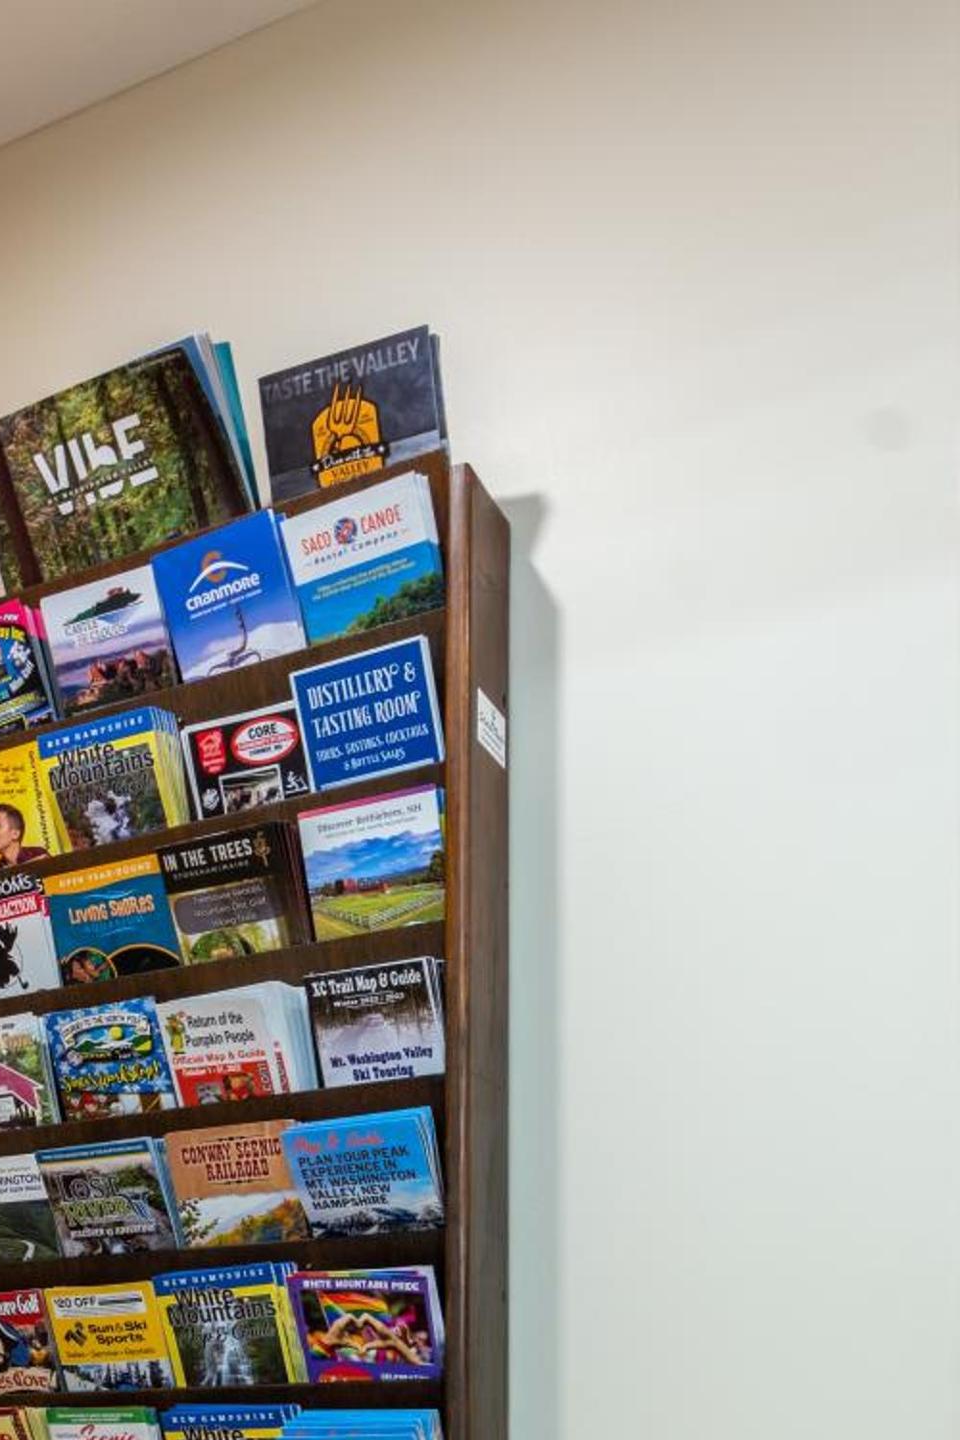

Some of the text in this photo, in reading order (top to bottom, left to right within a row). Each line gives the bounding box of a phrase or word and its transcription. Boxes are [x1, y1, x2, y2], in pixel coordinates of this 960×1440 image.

[263, 338, 420, 400] TASTE THE VALLEY
[301, 505, 401, 556] SACO CANOE
[307, 661, 416, 710] DISTILLERY &
[312, 691, 421, 739] TASTING ROOM
[46, 715, 144, 749] NEW HAMPSHIRE
[248, 723, 278, 740] CORE
[56, 742, 115, 770] White
[49, 751, 155, 791] Mountains
[406, 802, 422, 814] NH
[163, 838, 253, 871] IN THE TREES
[329, 978, 353, 995] Trail
[355, 976, 377, 993] Map
[389, 969, 421, 986] Guide
[218, 1012, 227, 1025] of
[228, 1012, 243, 1024] the
[224, 1029, 256, 1045] People
[347, 1051, 402, 1067] Washington
[402, 1046, 433, 1061] Valley
[352, 1064, 414, 1081] Ski Touring
[181, 1138, 281, 1164] CONWAY SCENIC
[298, 1146, 410, 1167] PLAN YOUR PEAK
[206, 1159, 270, 1182] RAILROAD
[301, 1160, 397, 1179] EXPERIENCE IN
[329, 1171, 416, 1186] WASHINGTON
[362, 1184, 390, 1195] NEW
[312, 1195, 389, 1210] HAMPSHIRE
[162, 1268, 265, 1288] NEW HAMPSHIRE
[302, 1279, 332, 1290] WHITE
[391, 1280, 420, 1291] PRIDE
[174, 1287, 234, 1306] White
[168, 1300, 277, 1328] Mountains
